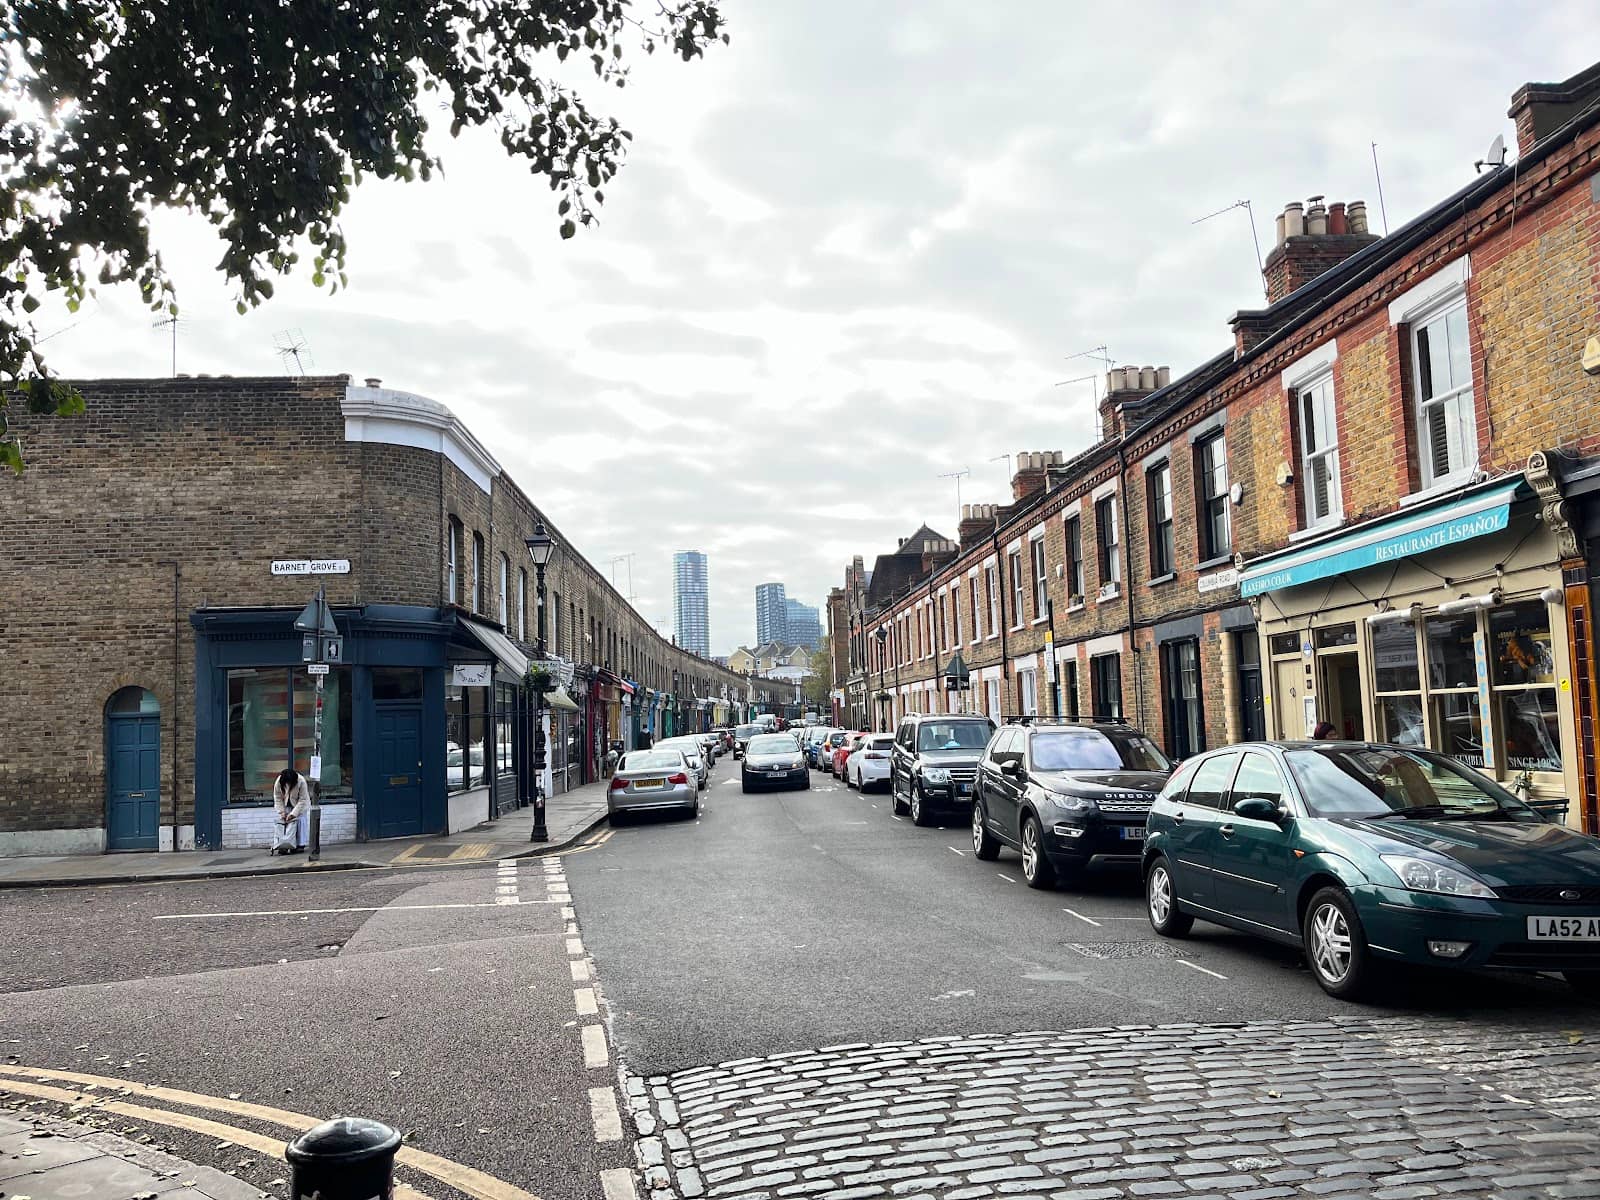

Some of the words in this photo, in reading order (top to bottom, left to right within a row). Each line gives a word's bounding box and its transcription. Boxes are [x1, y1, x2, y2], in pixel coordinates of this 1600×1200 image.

[1376, 529, 1446, 561] RESTAURANTE
[1449, 515, 1499, 541] ESPAÑOL
[274, 563, 306, 572] BARNET
[310, 562, 337, 571] GROVE
[1508, 757, 1535, 768] SINCE
[1536, 919, 1582, 937] LA52
